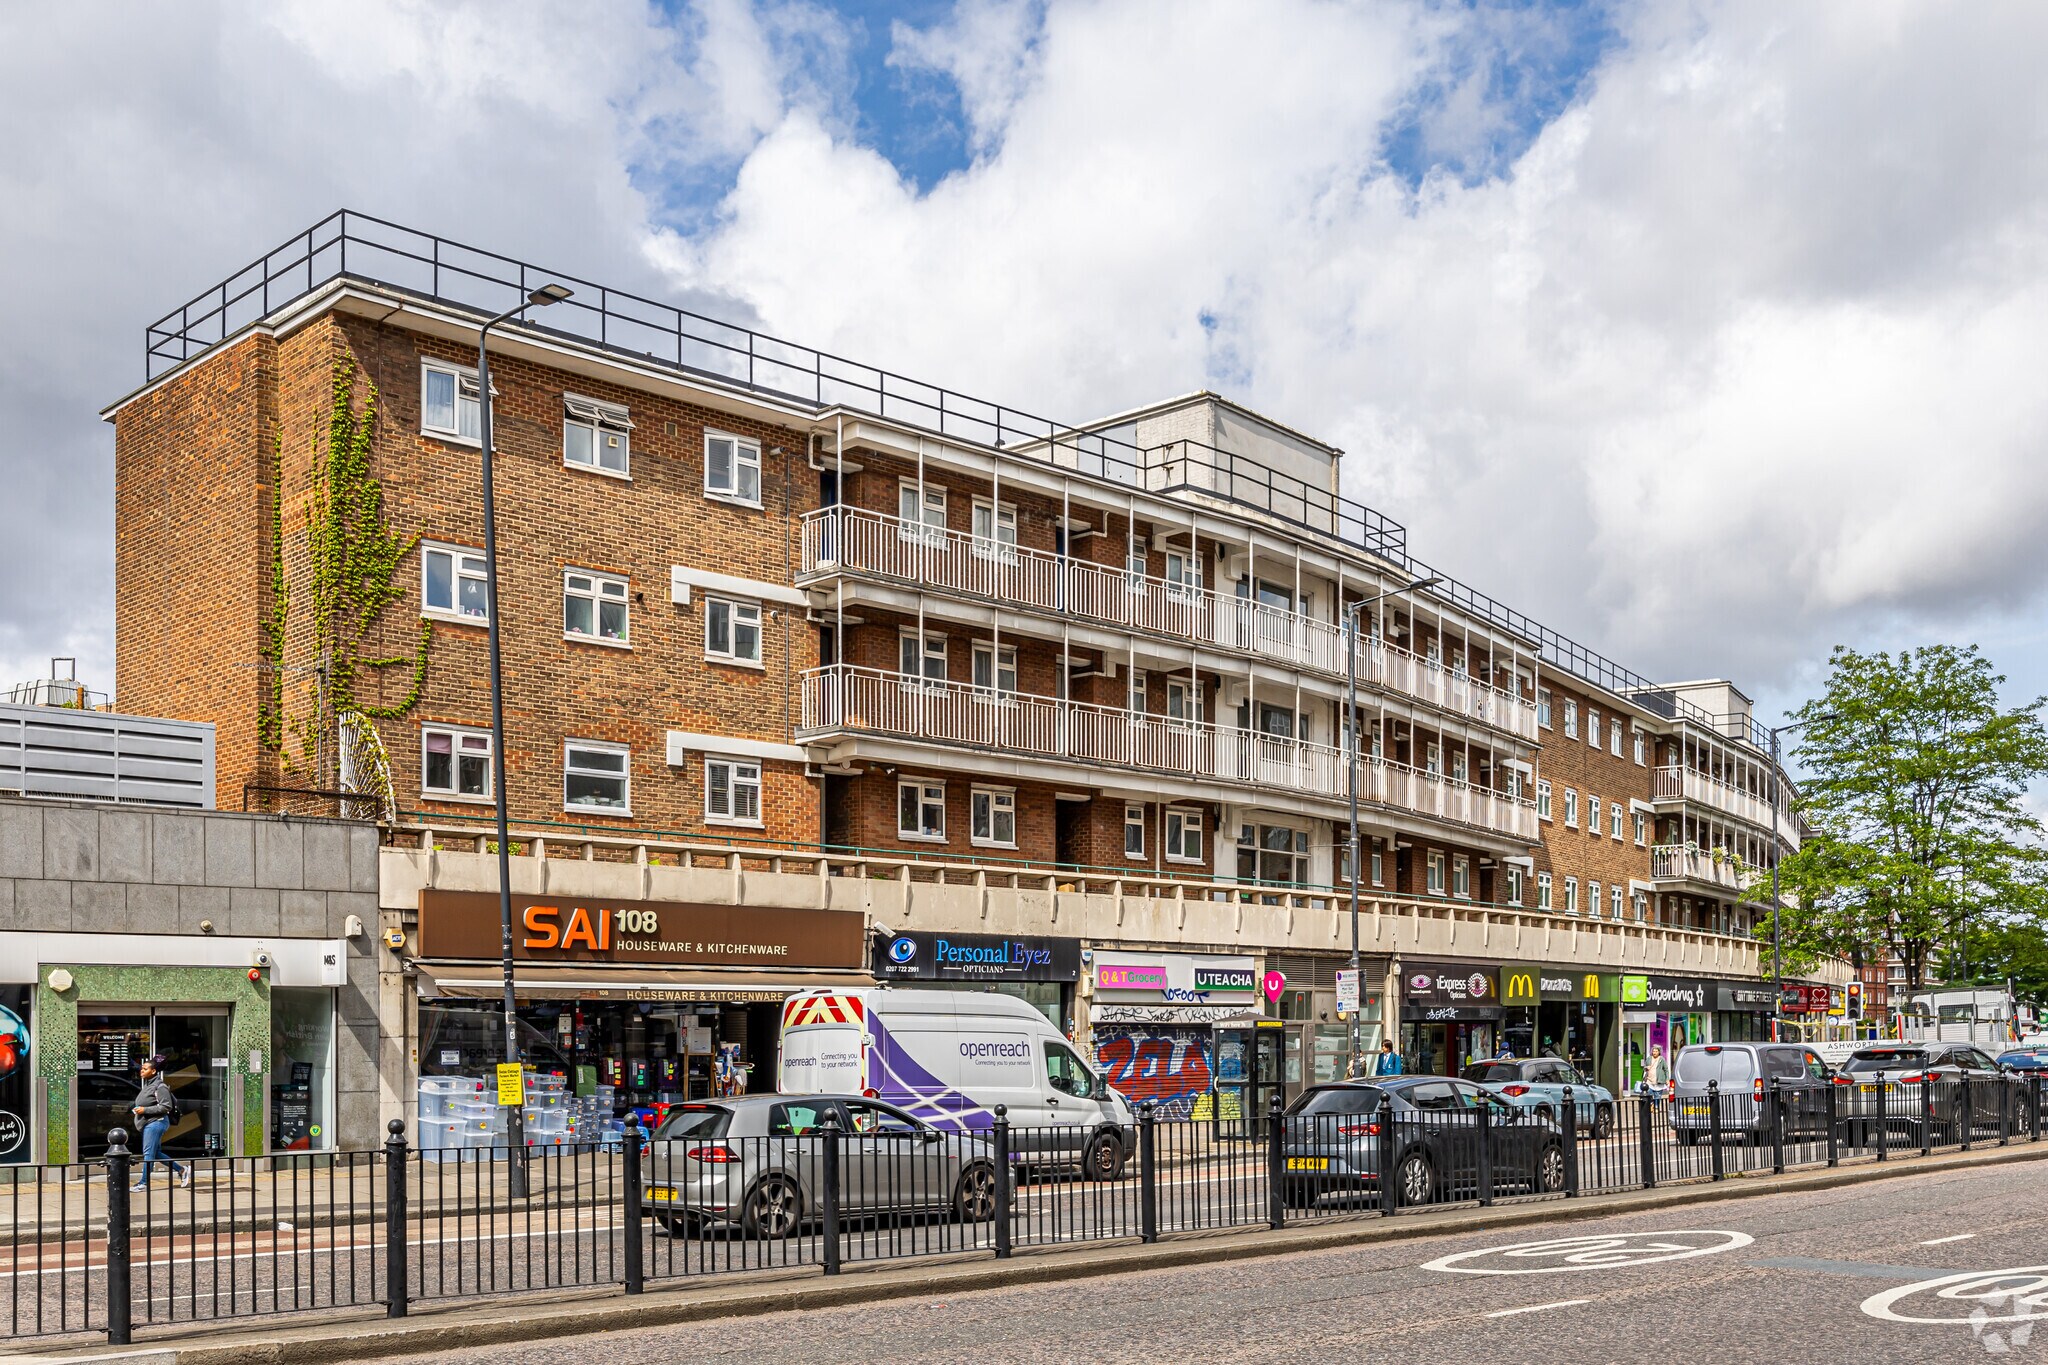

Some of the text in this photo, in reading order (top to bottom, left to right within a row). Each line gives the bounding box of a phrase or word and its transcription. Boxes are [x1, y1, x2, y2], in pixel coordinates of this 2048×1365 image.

[523, 905, 658, 950] SAI 108
[616, 940, 788, 956] HOUSEWARE & KITCHENWARE
[324, 955, 336, 965] M&S
[936, 939, 1051, 971] Personal Eyez
[963, 965, 1004, 974] OPTICIANS
[1101, 971, 1109, 985] Q
[1111, 971, 1119, 982] &
[1268, 979, 1279, 991] U
[626, 990, 696, 1000] HOUSEWARE
[700, 991, 707, 1001] &
[710, 991, 784, 1001] KITCHENWARE
[1449, 991, 1467, 1000] Opticians
[1646, 980, 1695, 1008] Superdrug
[960, 1041, 1031, 1059] openreach
[1827, 1041, 1879, 1050] ASHWORTH
[821, 1052, 847, 1060] Connecting
[784, 1057, 817, 1068] openreach
[837, 1060, 858, 1068] network
[6, 1121, 16, 1129] at
[1, 1130, 19, 1142] peak
